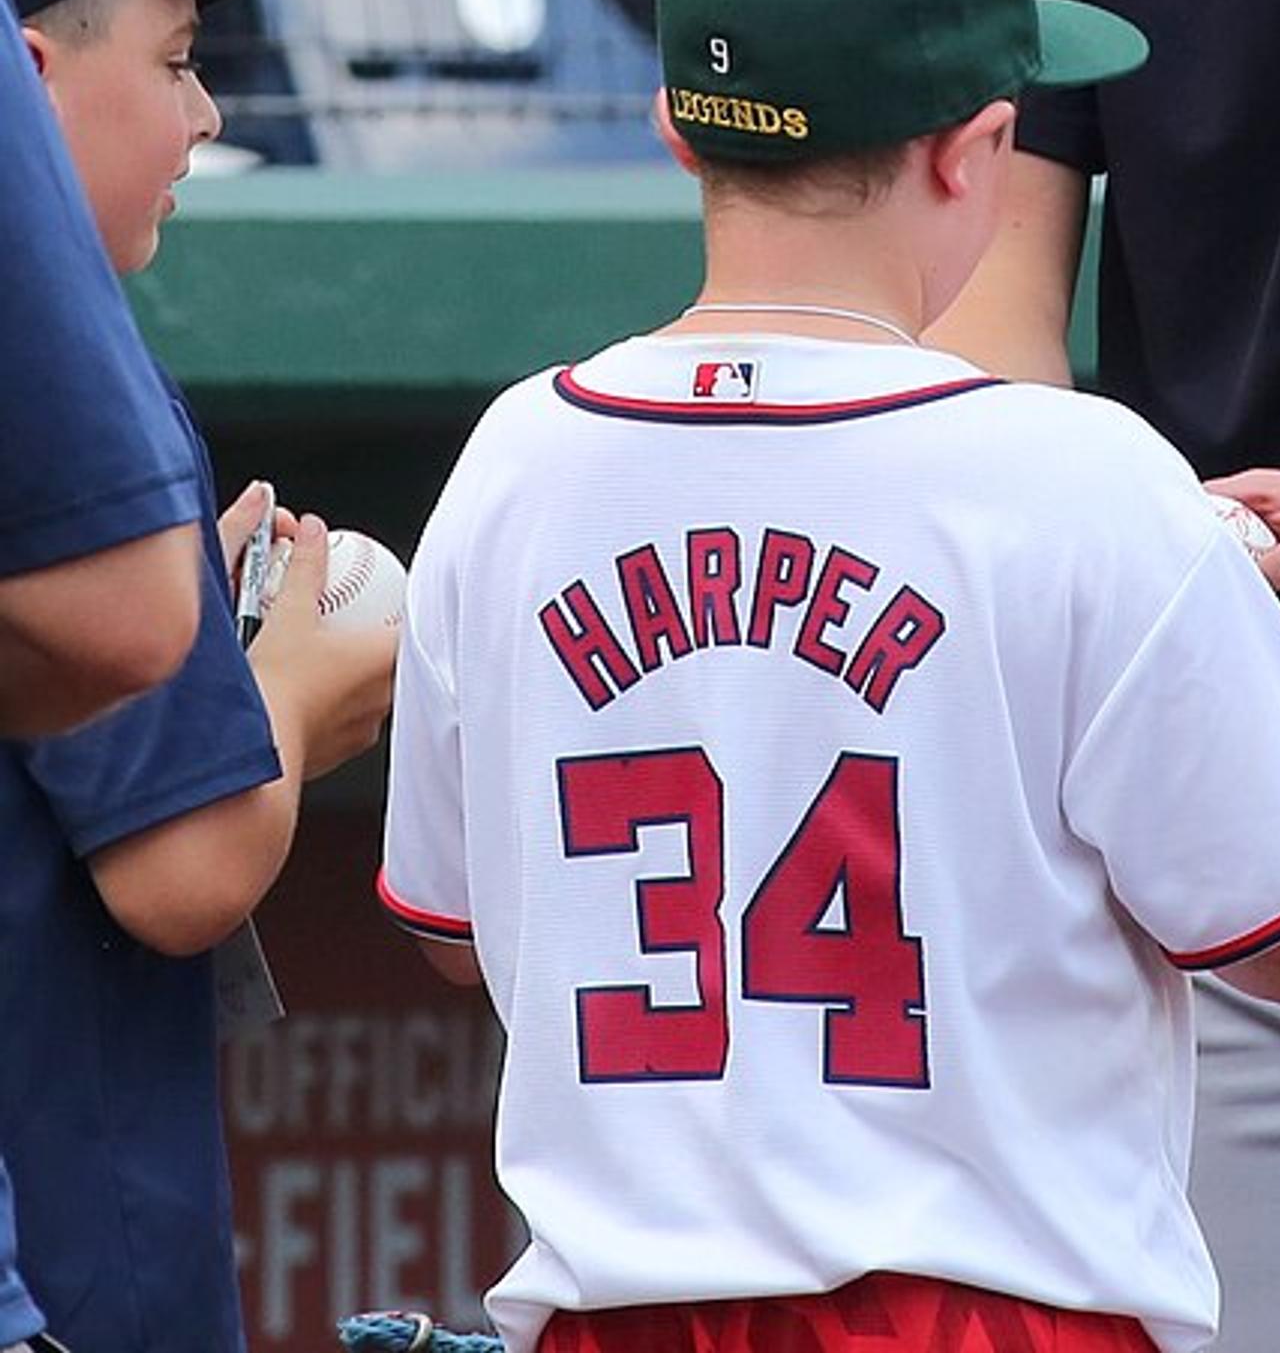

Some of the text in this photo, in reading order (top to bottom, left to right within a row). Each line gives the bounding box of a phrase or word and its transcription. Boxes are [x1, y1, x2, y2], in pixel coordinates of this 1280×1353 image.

[671, 87, 809, 139] LEGENDS
[711, 38, 730, 74] 9
[538, 526, 946, 714] HARPER
[555, 742, 931, 1089] 34
